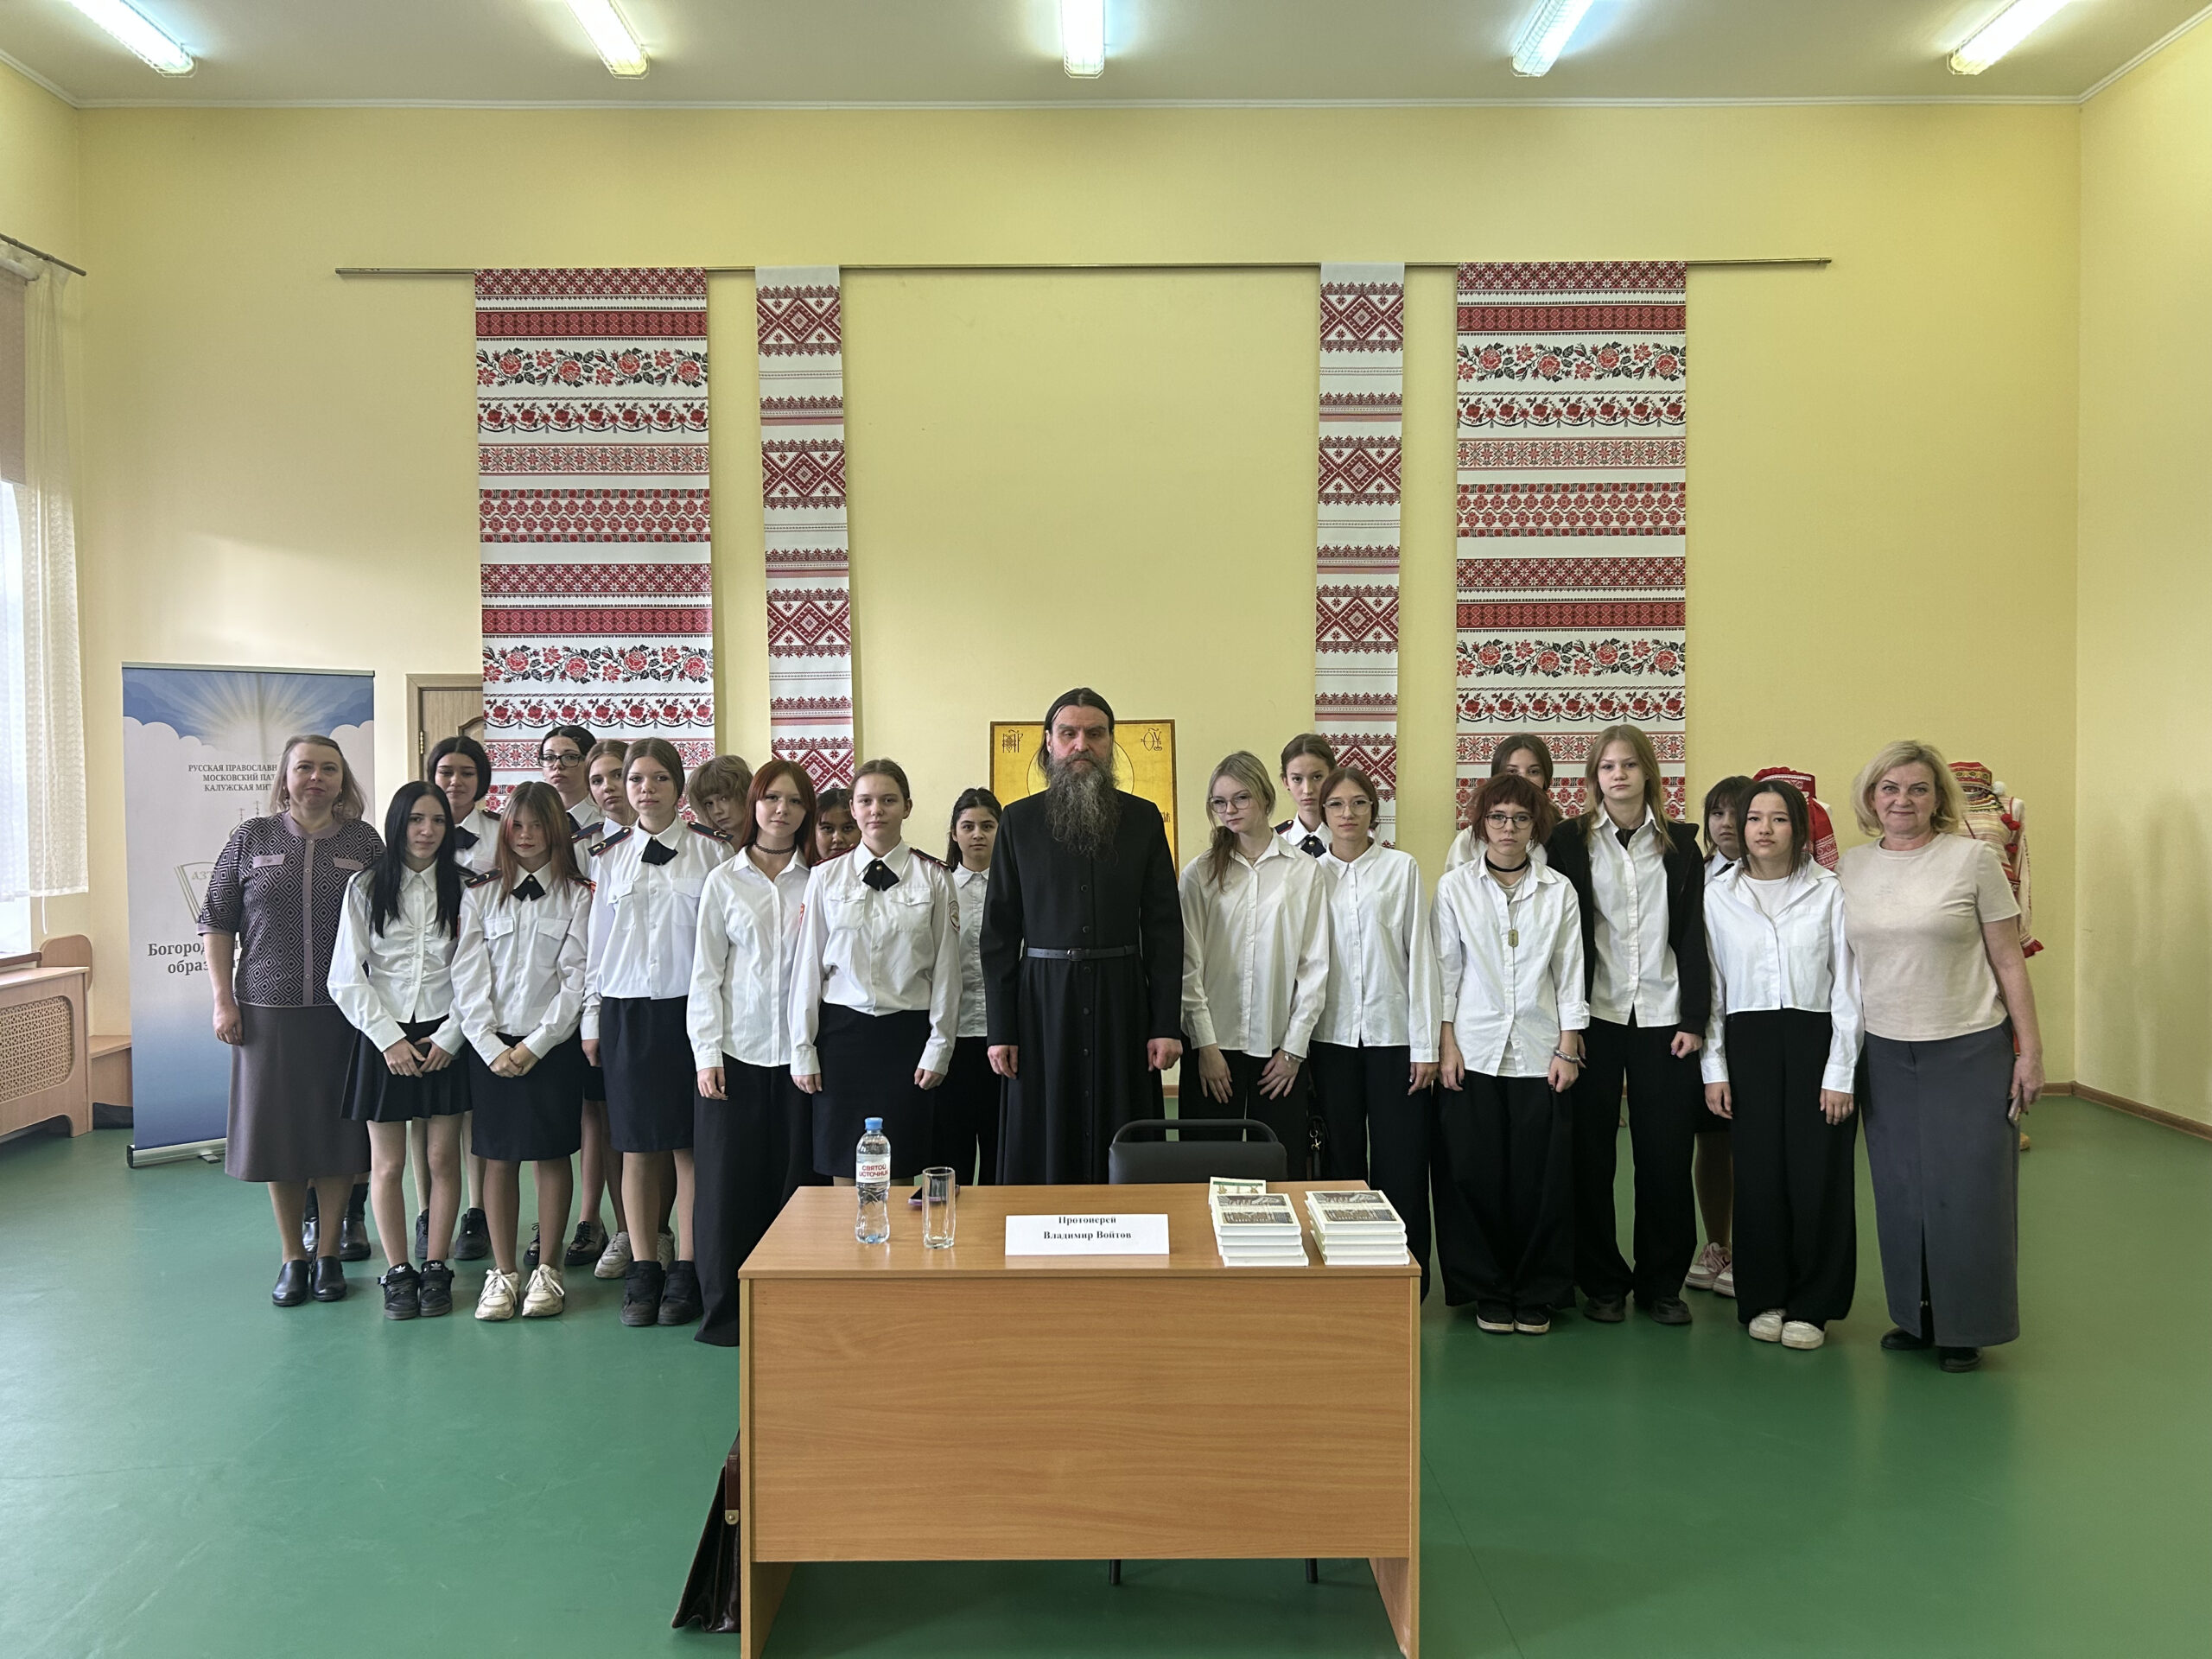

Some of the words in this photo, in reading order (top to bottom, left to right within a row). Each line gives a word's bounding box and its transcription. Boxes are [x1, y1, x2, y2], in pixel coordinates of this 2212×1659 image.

[1058, 1216, 1116, 1225] Протоиерей
[1044, 1231, 1094, 1241] Владимир
[1096, 1230, 1132, 1239] Войтов
